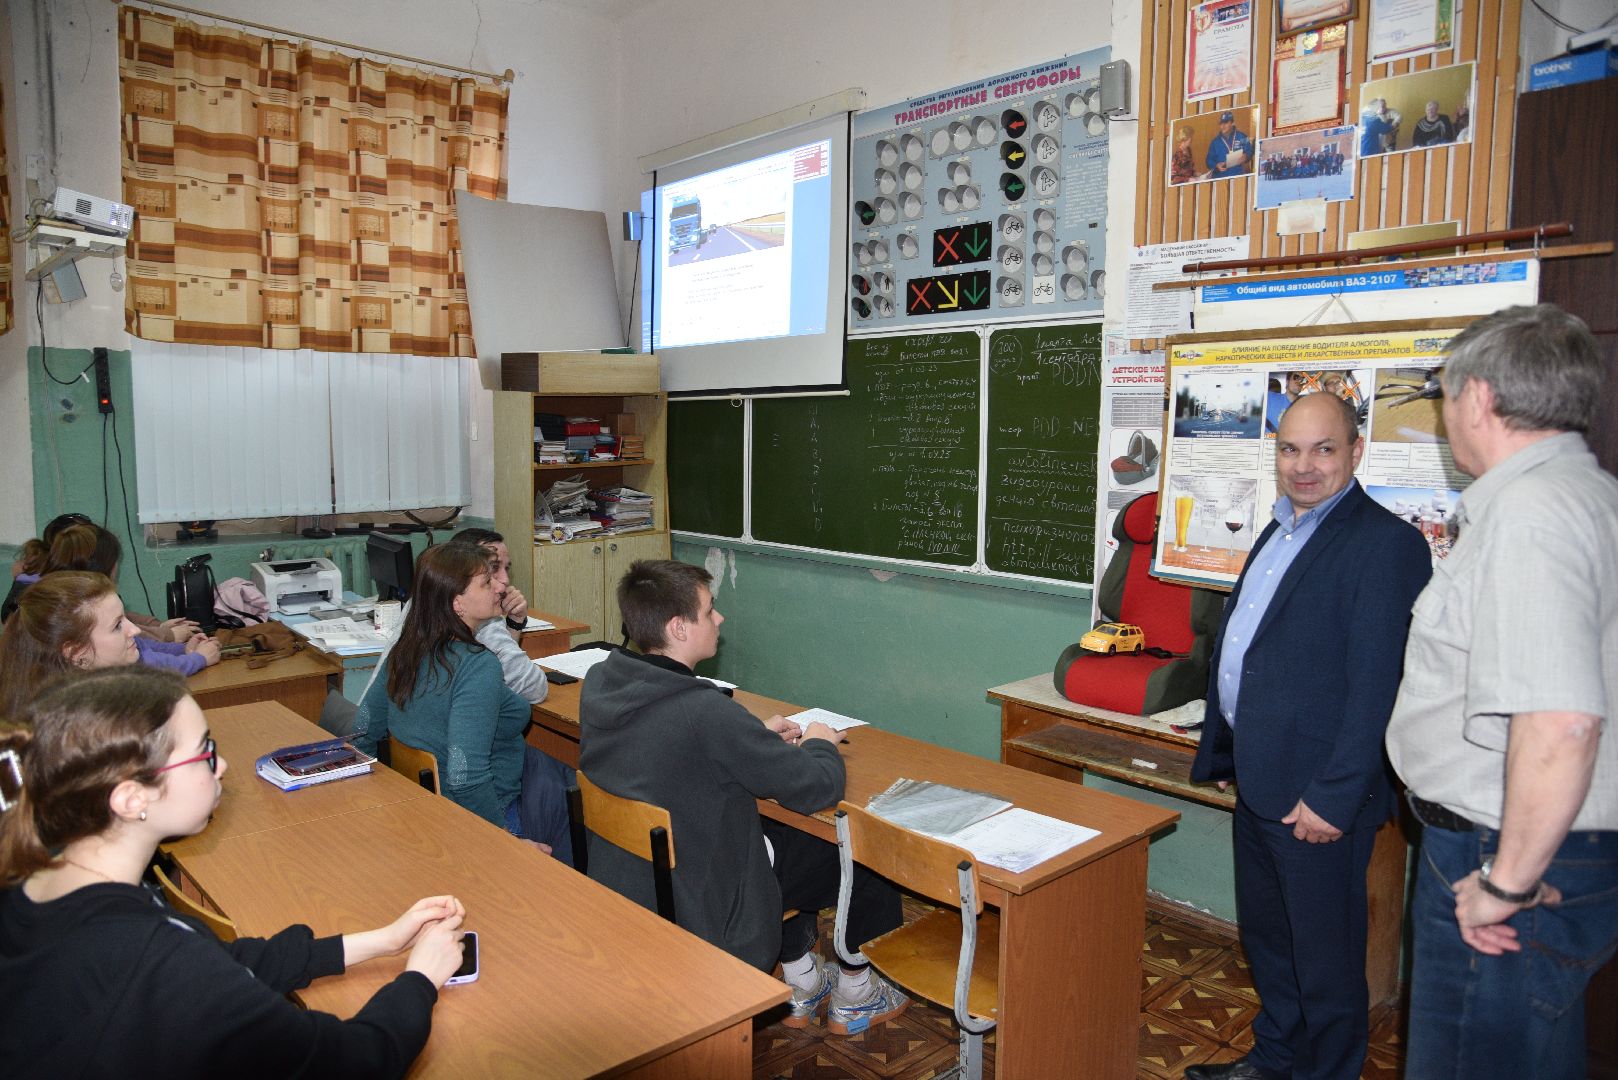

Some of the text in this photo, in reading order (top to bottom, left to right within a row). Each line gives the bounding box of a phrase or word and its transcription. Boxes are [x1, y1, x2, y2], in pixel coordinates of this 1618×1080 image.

[1534, 61, 1572, 76] brother
[938, 83, 985, 102] РЕГУЛИРОВАНИЯ
[988, 71, 1028, 87] ДОРОЖНОГО
[1030, 61, 1068, 76] ДВИЖЕНИЯ
[894, 66, 1081, 126] ТРАНСПОРТНЫЕ СВЕТОФОРЫ
[1236, 285, 1267, 295] Общий
[1268, 284, 1286, 293] вид
[1346, 274, 1397, 287] ВАЗ-2107
[1215, 353, 1265, 362] НАРКОТИЧЕСКИХ
[1266, 351, 1296, 361] ВЕЩЕСТВ
[1303, 349, 1361, 358] ЛЕКАРСТВЕННЫХ
[1363, 347, 1411, 356] ПРЕПАРАТОВ
[1231, 345, 1261, 354] ВЛИЯНИЕ
[1272, 343, 1311, 352] ПОВЕДЕНИЕ
[1312, 341, 1349, 350] ВОДИТЕЛЯ
[1112, 366, 1149, 374] ДЕТСКОЕ
